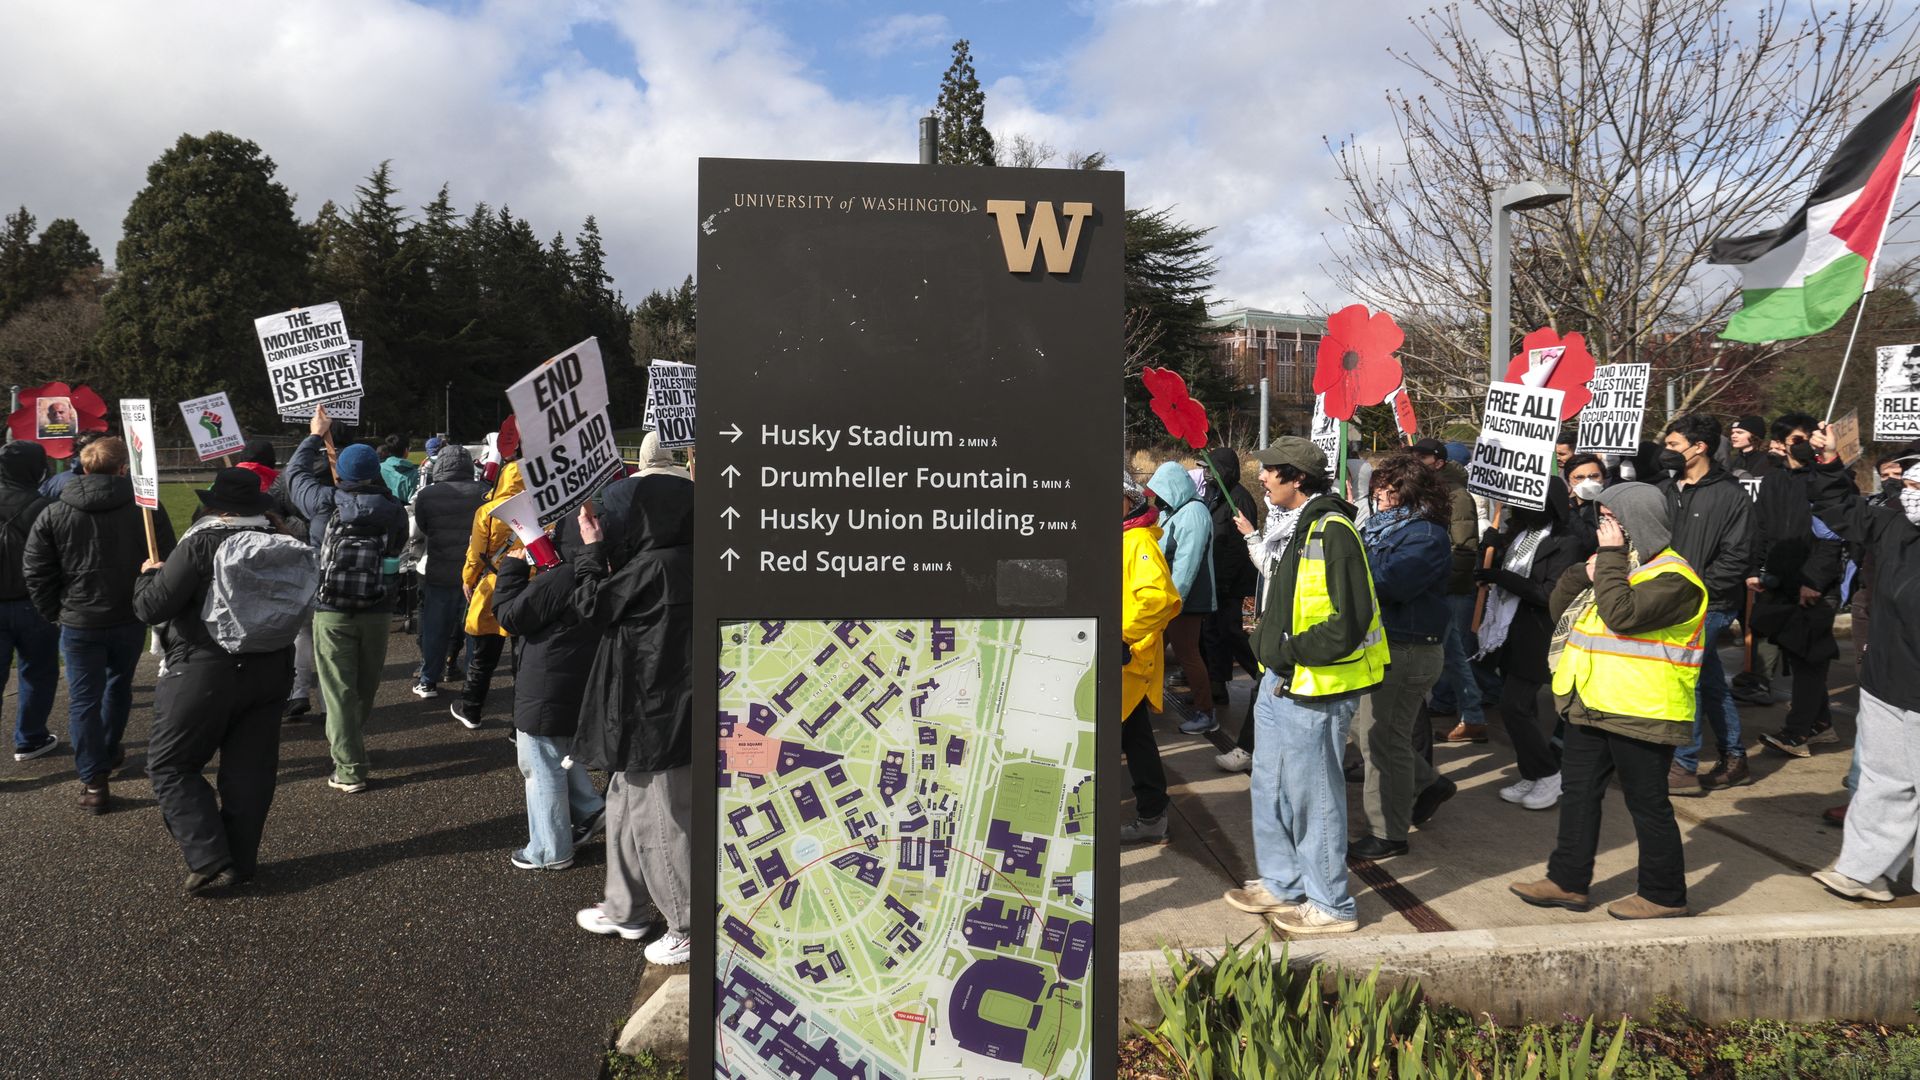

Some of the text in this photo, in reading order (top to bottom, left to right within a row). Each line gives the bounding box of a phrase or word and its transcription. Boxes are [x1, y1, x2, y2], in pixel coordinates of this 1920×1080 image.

[734, 193, 971, 213] UNIVERSITY of WASHINGTON
[987, 200, 1093, 273] W
[285, 311, 313, 329] THE
[263, 321, 344, 351] MOVEMENT
[268, 336, 347, 362] CONTINUES UNTIL
[272, 353, 352, 384] PALESTINE
[651, 367, 679, 378] STAND
[1596, 365, 1647, 378] TAND WITH
[276, 368, 357, 404] IS FREE!
[532, 352, 583, 413] END
[1589, 378, 1646, 391] PALESTINE!
[655, 389, 681, 406] END
[683, 389, 696, 405] TH
[1487, 389, 1557, 421] FREE ALL
[1586, 391, 1643, 409] ND THE
[1884, 398, 1920, 412] RELE
[133, 413, 146, 421] SEA
[546, 390, 588, 444] ALL
[655, 407, 696, 419] OCCUPAT
[1581, 410, 1640, 423] OCCUPATION
[762, 424, 989, 452] Husky Stadium 2 MIN
[1484, 415, 1555, 442] PALESTINIAN
[1579, 422, 1636, 447] NOW!
[1882, 422, 1919, 431] KHA
[199, 434, 238, 448] PALESTINE
[525, 413, 607, 488] U.S. AID
[1474, 442, 1547, 477] POLITICAL
[533, 439, 614, 512] TO ISRAEL!
[761, 466, 1062, 489] Drumheller Fountain 5 MIN
[1470, 465, 1545, 497] PRISONERS
[761, 508, 1068, 536] Husky Union Building 7 MIN
[760, 550, 943, 578] Red Square 8 MIN
[829, 899, 842, 922] RAINIER
[845, 934, 855, 950] VISTA
